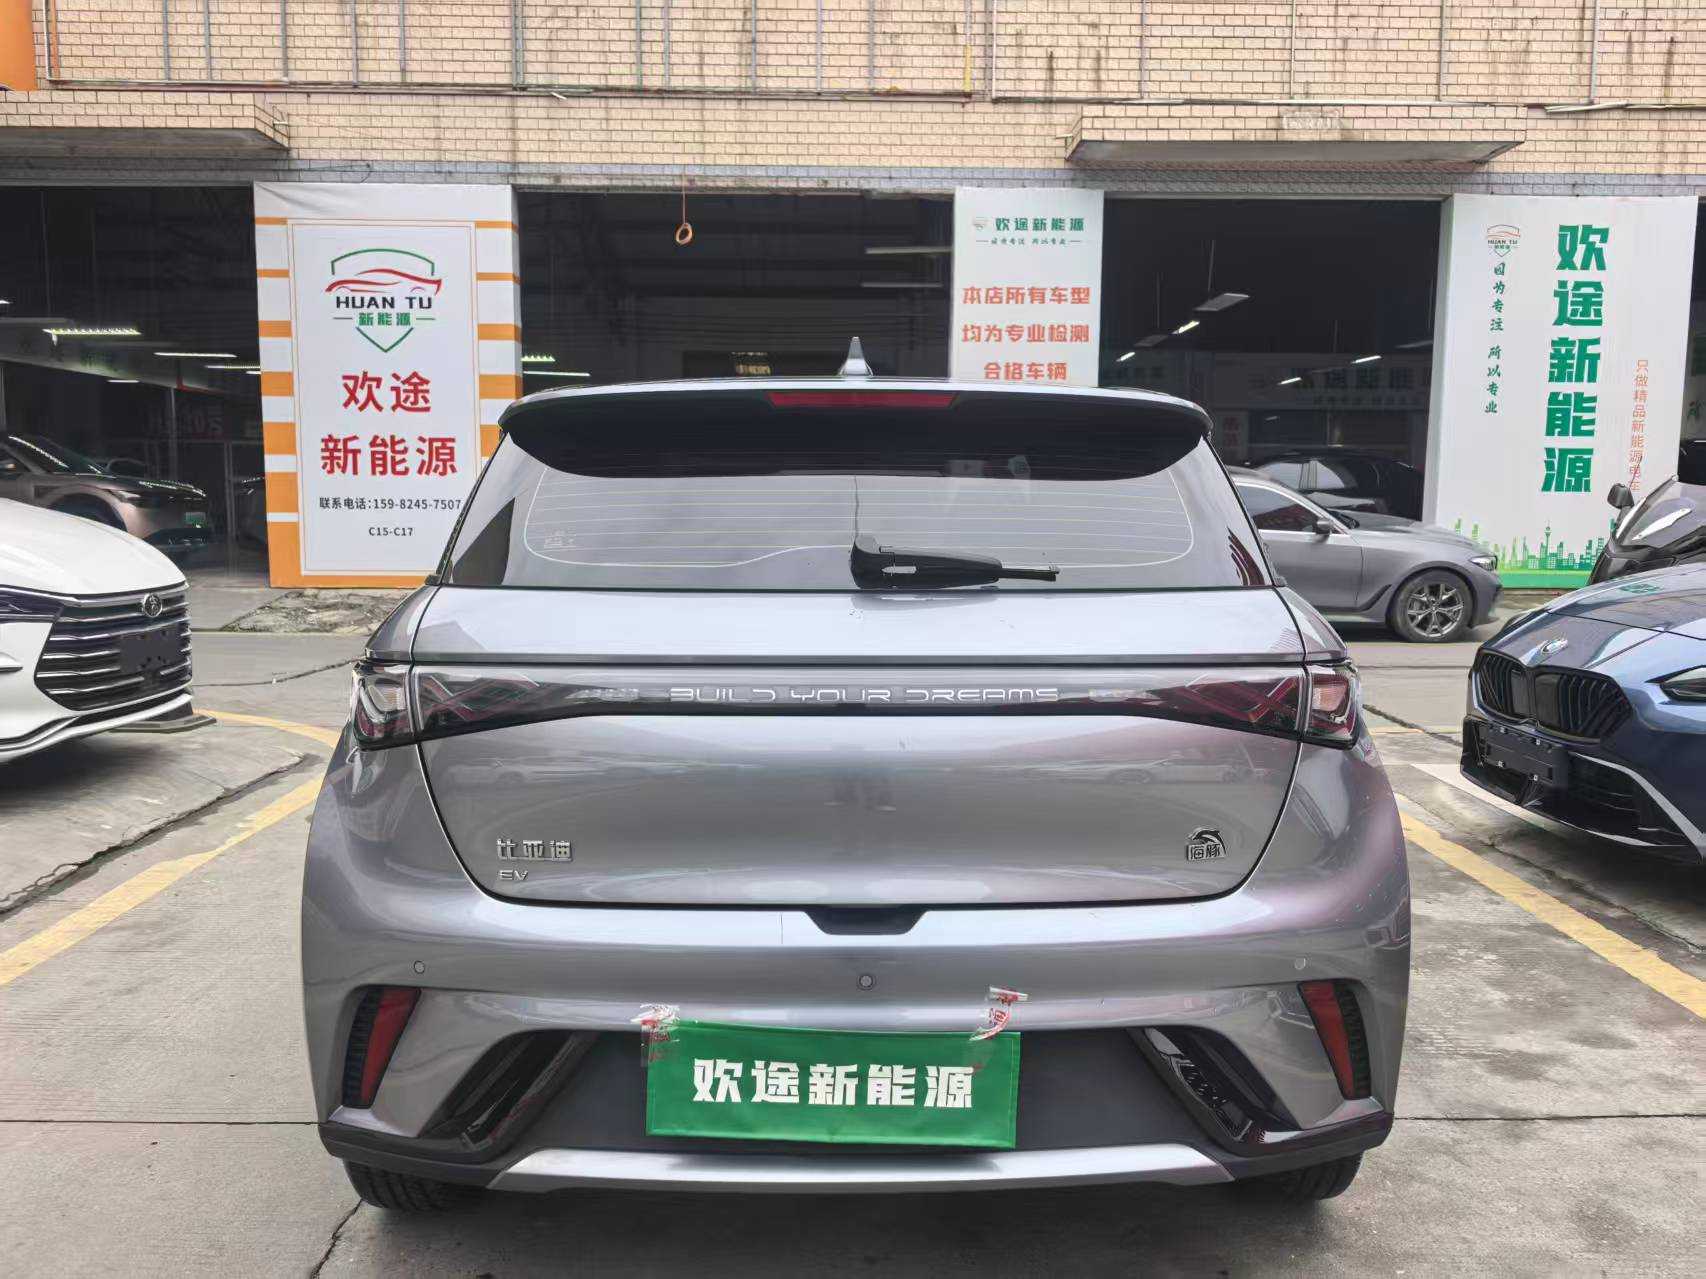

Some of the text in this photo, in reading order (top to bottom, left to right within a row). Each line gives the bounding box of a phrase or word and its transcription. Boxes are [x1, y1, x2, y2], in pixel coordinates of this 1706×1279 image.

[995, 218, 1084, 231] 欢途新能源
[336, 297, 432, 309] HUAN TU
[963, 287, 1090, 304] 本店所有车型
[1490, 262, 1506, 331] 因为专注
[358, 313, 411, 326] 新能源
[962, 324, 1089, 342] 均为专业检测
[1541, 225, 1609, 492] 欢途新能源
[984, 362, 1067, 380] 合格车辆
[1485, 346, 1502, 413] 所以专业
[341, 371, 431, 412] 欢途
[320, 434, 458, 476] 新能源
[368, 527, 413, 536] C15-C17
[670, 687, 1059, 703] BUILD YOUR DREAMS
[496, 838, 572, 861] 比亚迪
[498, 869, 528, 880] EV
[693, 1058, 974, 1108] 欢途新能源
